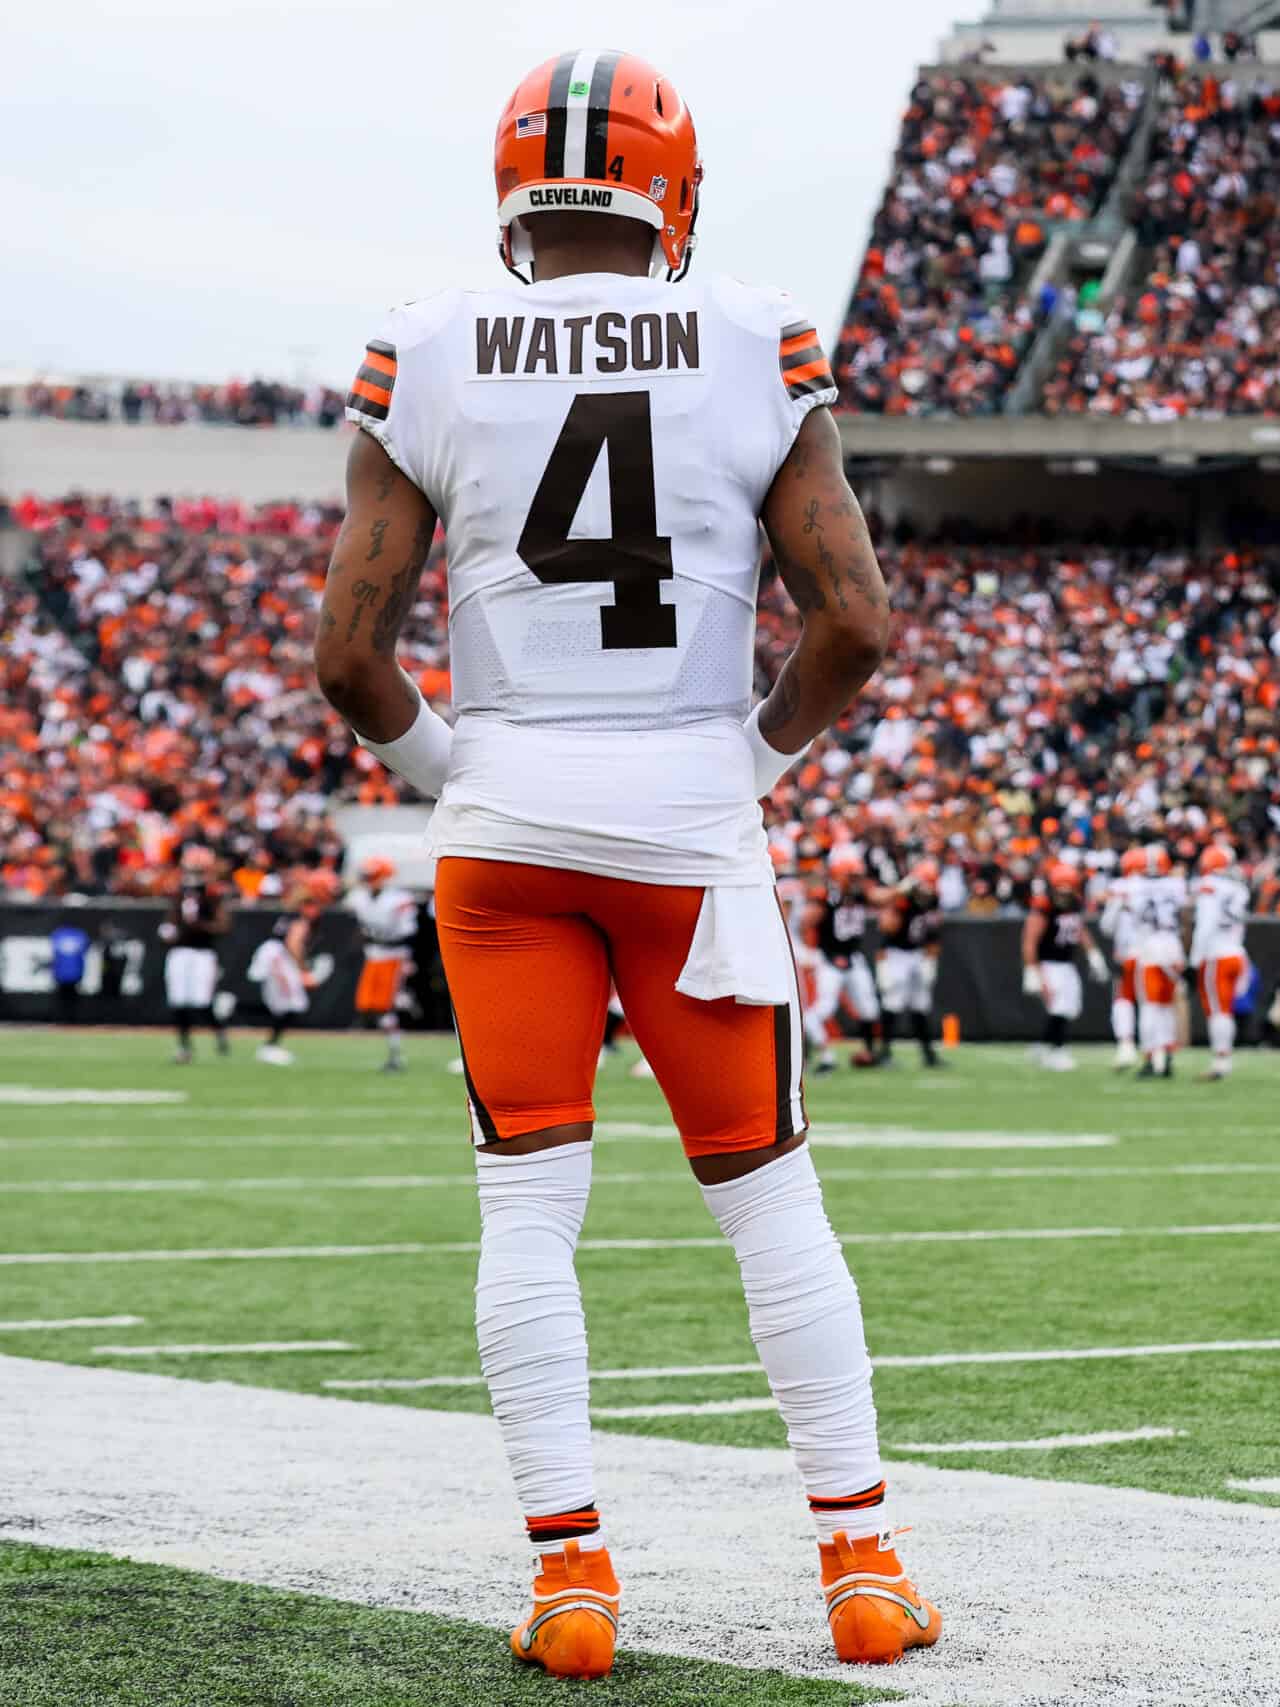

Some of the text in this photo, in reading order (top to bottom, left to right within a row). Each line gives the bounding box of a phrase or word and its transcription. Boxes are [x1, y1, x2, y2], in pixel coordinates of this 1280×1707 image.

[608, 155, 624, 182] 4
[529, 188, 613, 207] CLEVELAND
[475, 311, 700, 375] WATSON
[516, 390, 677, 649] 4
